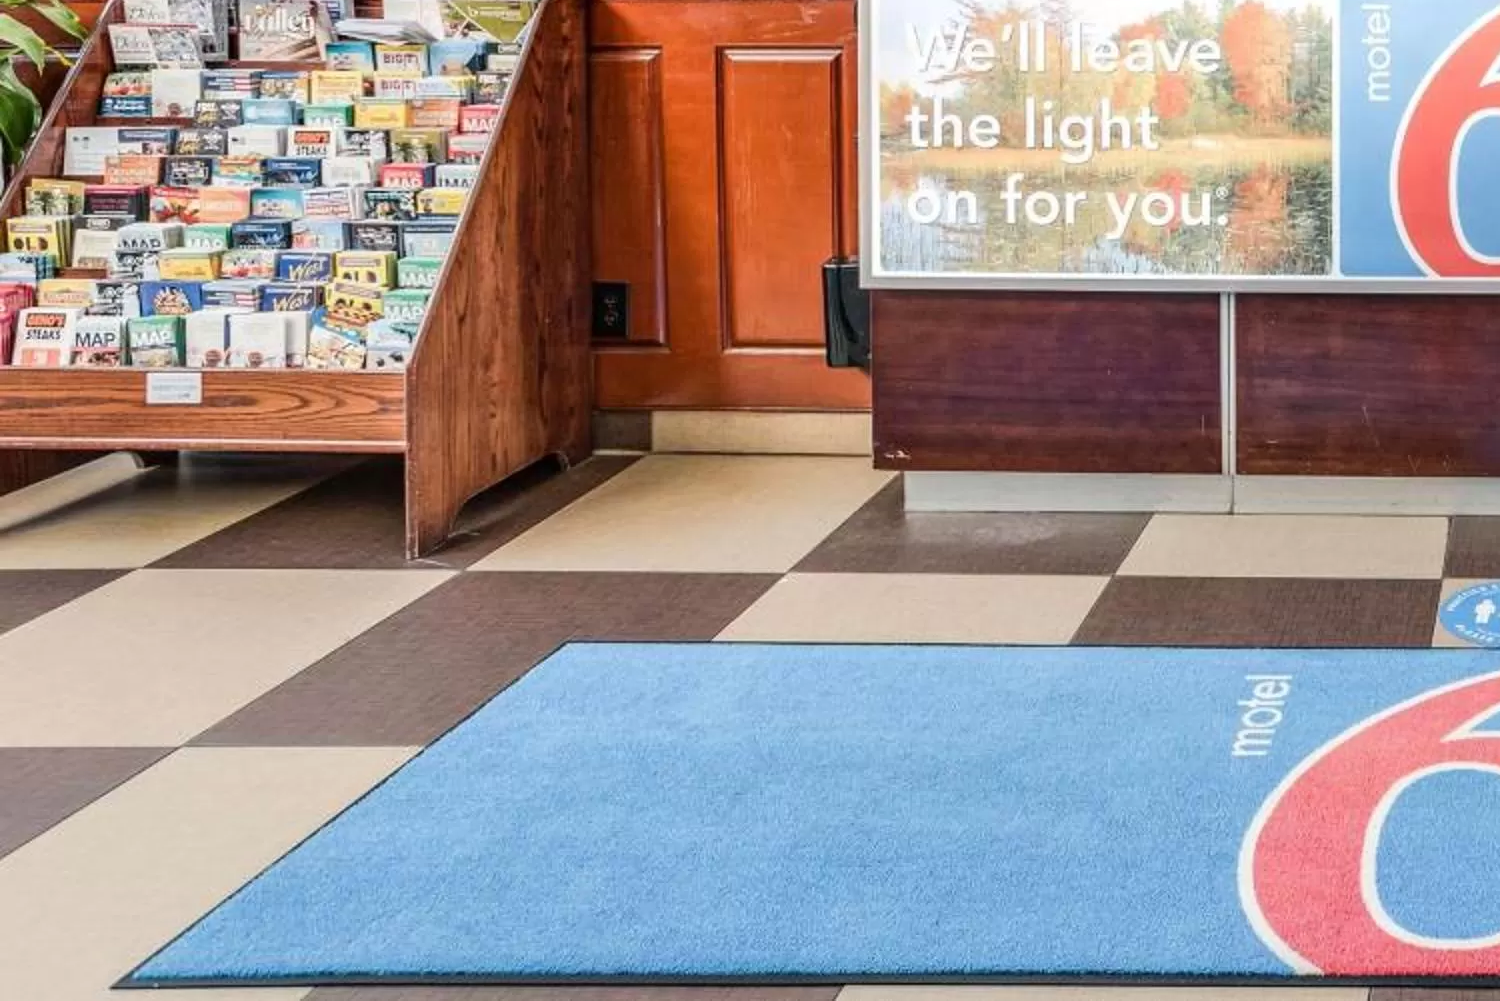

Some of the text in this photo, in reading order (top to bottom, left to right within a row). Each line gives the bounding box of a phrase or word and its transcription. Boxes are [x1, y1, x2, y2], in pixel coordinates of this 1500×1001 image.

[906, 20, 1222, 73] We'll leave
[1364, 2, 1392, 102] motel
[905, 97, 1160, 165] the light
[907, 183, 977, 226] on
[1000, 173, 1086, 226] for
[26, 329, 61, 340] STEAKS
[75, 332, 116, 348] MAP
[132, 328, 174, 347] MAP
[1231, 673, 1293, 758] motel
